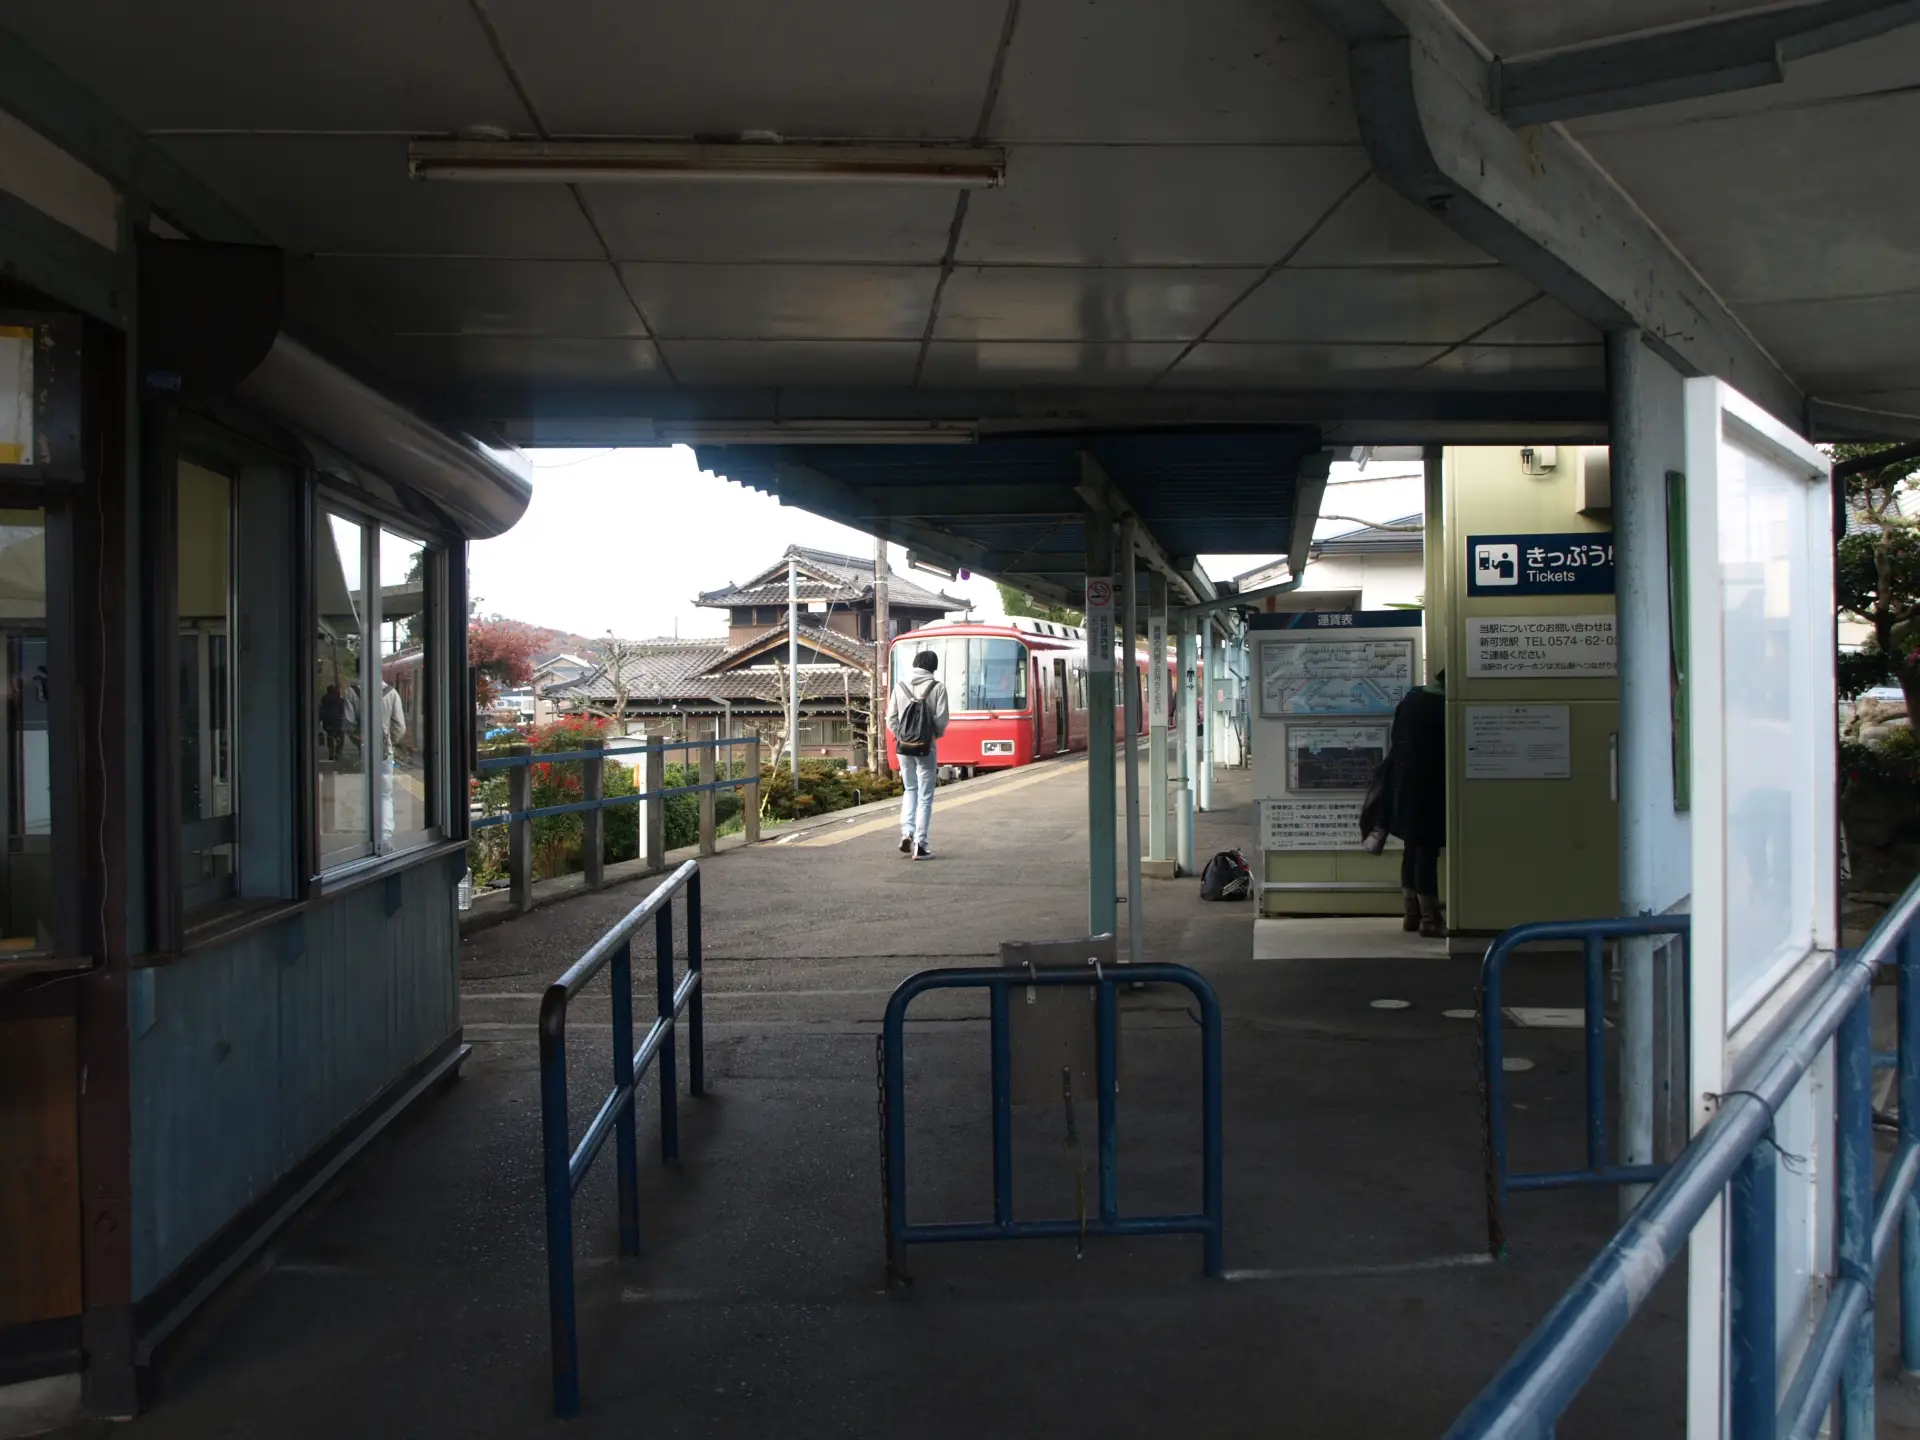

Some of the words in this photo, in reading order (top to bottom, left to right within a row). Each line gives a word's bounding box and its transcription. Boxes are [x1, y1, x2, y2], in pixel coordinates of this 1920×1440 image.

[1526, 570, 1576, 582] Tickets
[1317, 614, 1353, 626] 運賃表
[1479, 622, 1612, 634] 当駅についてのお問い合わせは
[1480, 636, 1519, 647] 新可児駅
[1480, 648, 1546, 660] ご連絡ください
